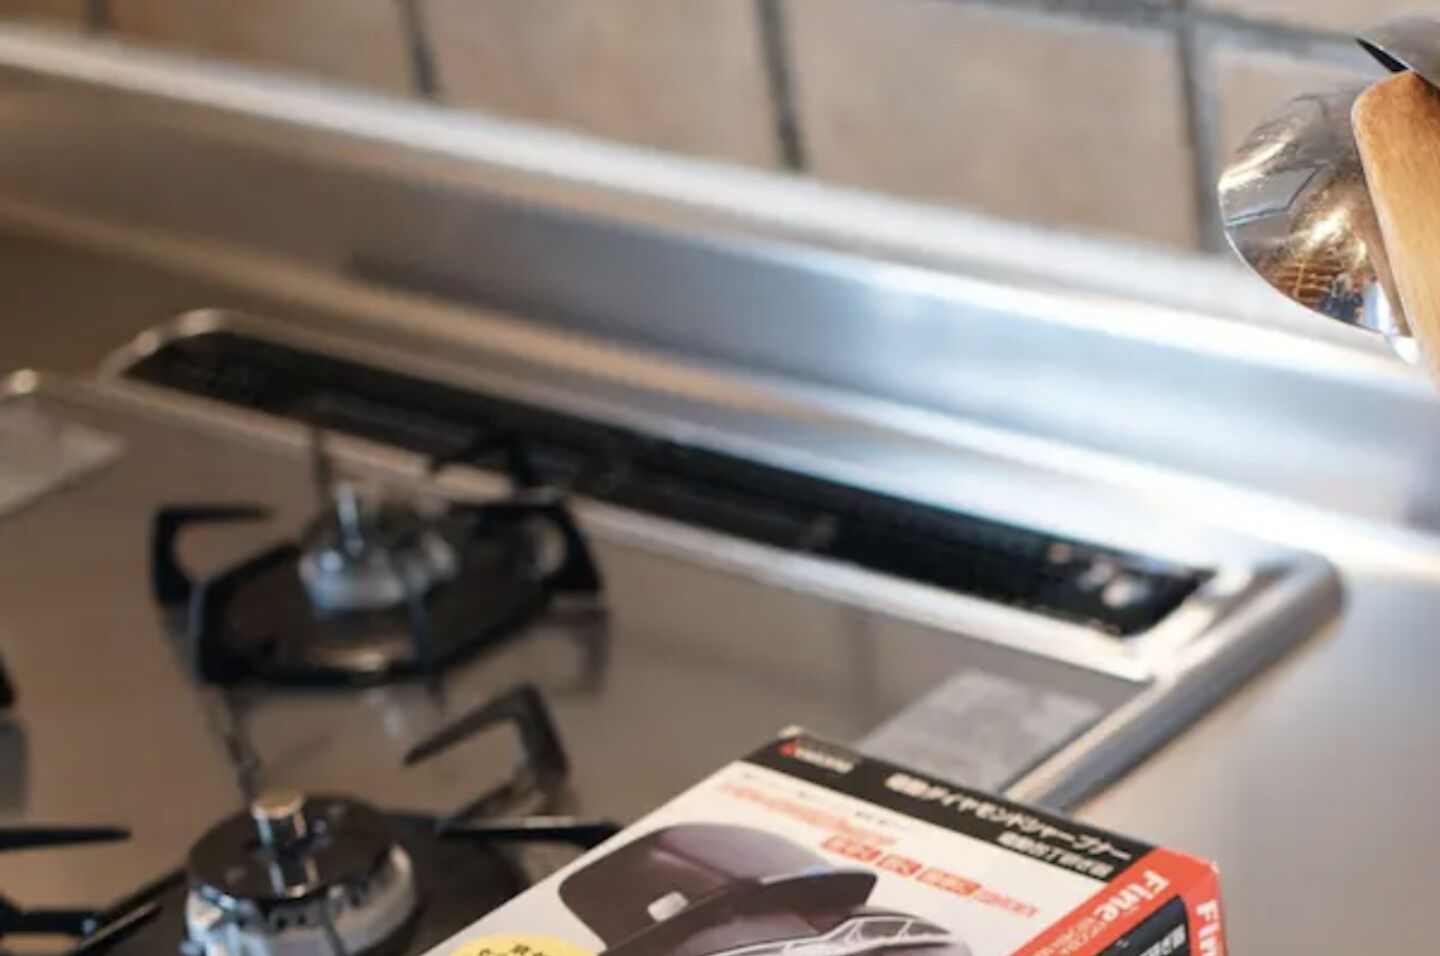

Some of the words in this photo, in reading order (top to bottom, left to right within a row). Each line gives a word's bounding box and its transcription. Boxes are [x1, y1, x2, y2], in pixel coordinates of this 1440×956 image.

[885, 772, 1132, 861] 電動ダイヤモンドシャープナー
[1094, 869, 1170, 923] Fine
